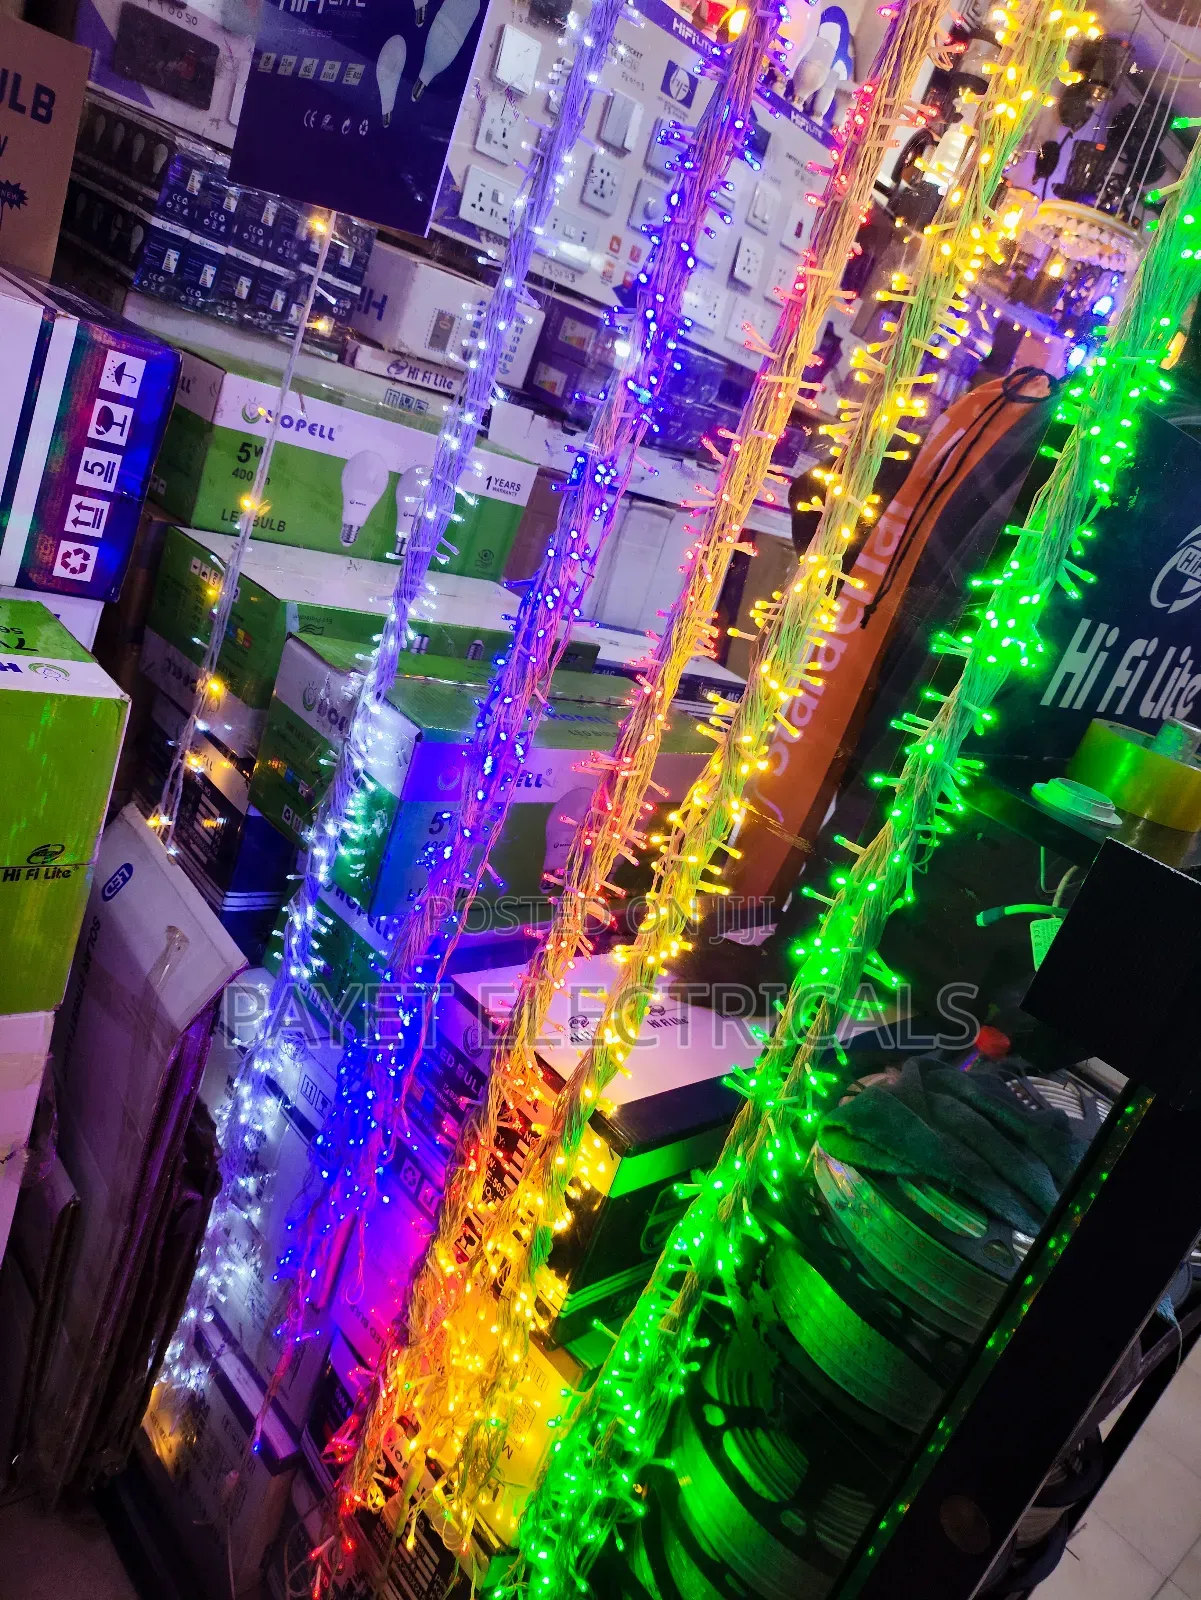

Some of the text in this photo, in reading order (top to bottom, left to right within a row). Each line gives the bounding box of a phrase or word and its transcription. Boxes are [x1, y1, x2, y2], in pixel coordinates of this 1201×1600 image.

[406, 366, 419, 381] Hi
[433, 373, 454, 391] Lite
[486, 475, 521, 492] 1 YEARS
[221, 508, 242, 523] LE
[1039, 617, 1201, 721] Hi Fi Lite
[2, 866, 72, 883] Hi Fi Lite
